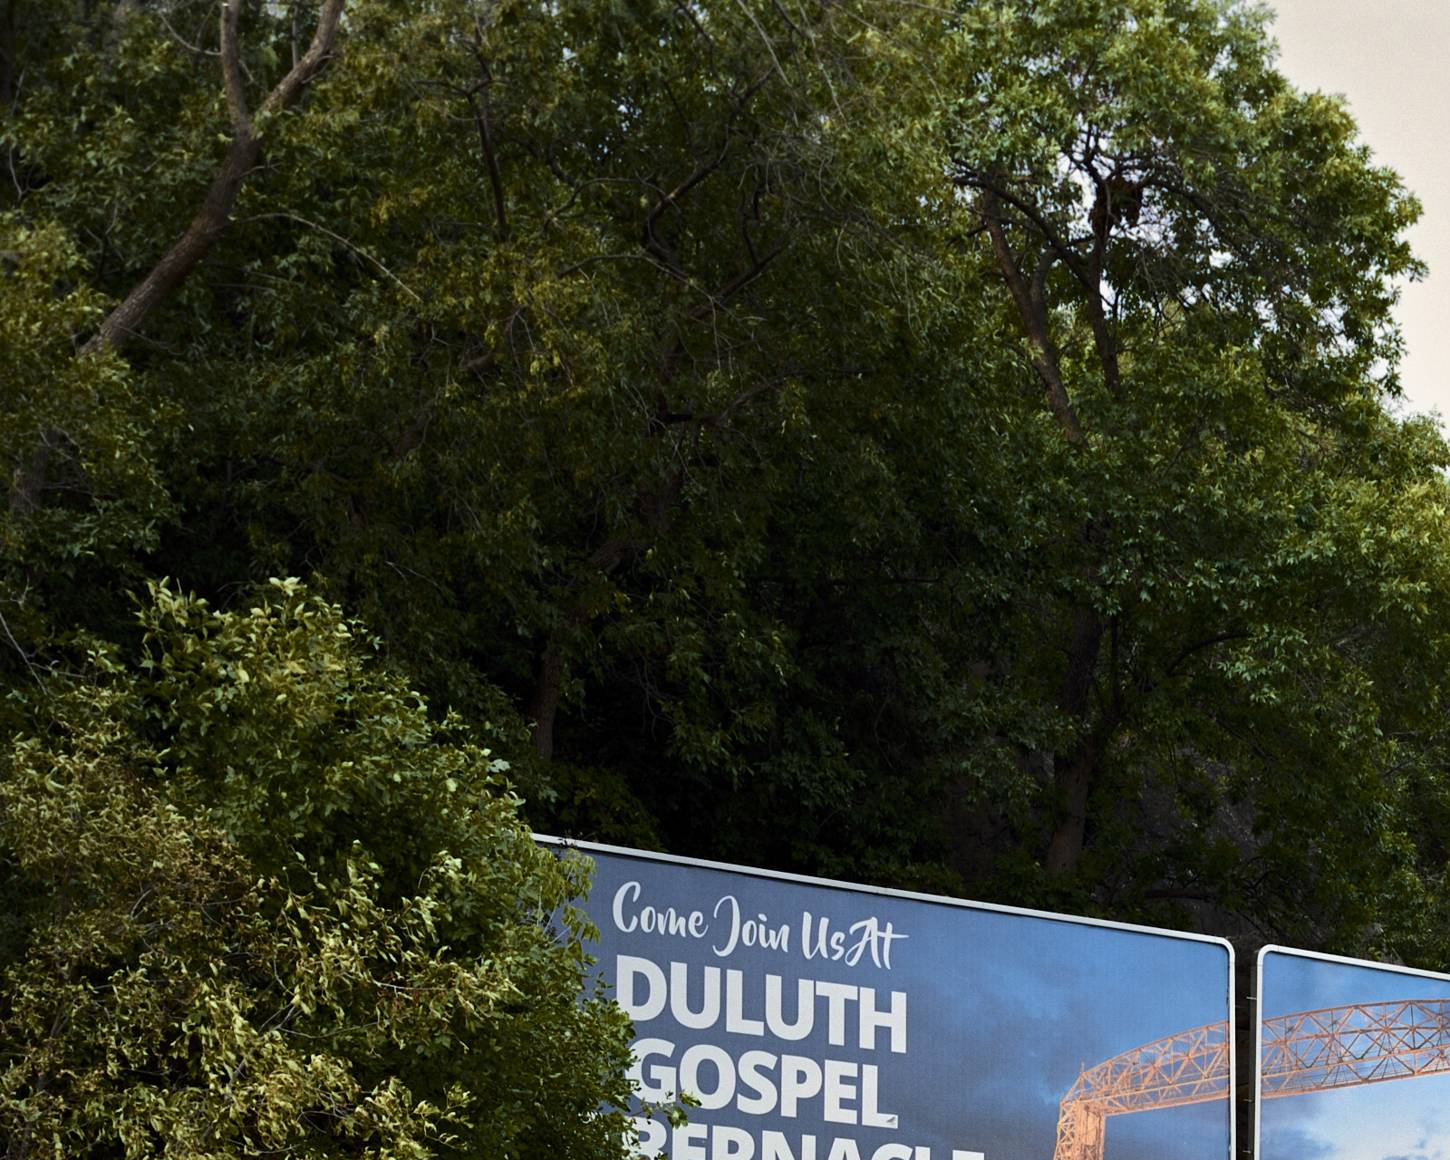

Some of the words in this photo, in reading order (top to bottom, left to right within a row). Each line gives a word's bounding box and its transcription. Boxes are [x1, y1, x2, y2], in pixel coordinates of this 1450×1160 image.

[612, 881, 709, 936] Come
[712, 895, 790, 958] Join
[802, 911, 846, 962] Us
[845, 916, 910, 970] At
[616, 955, 908, 1054] DULUTH
[624, 1038, 898, 1129] GOSPEL
